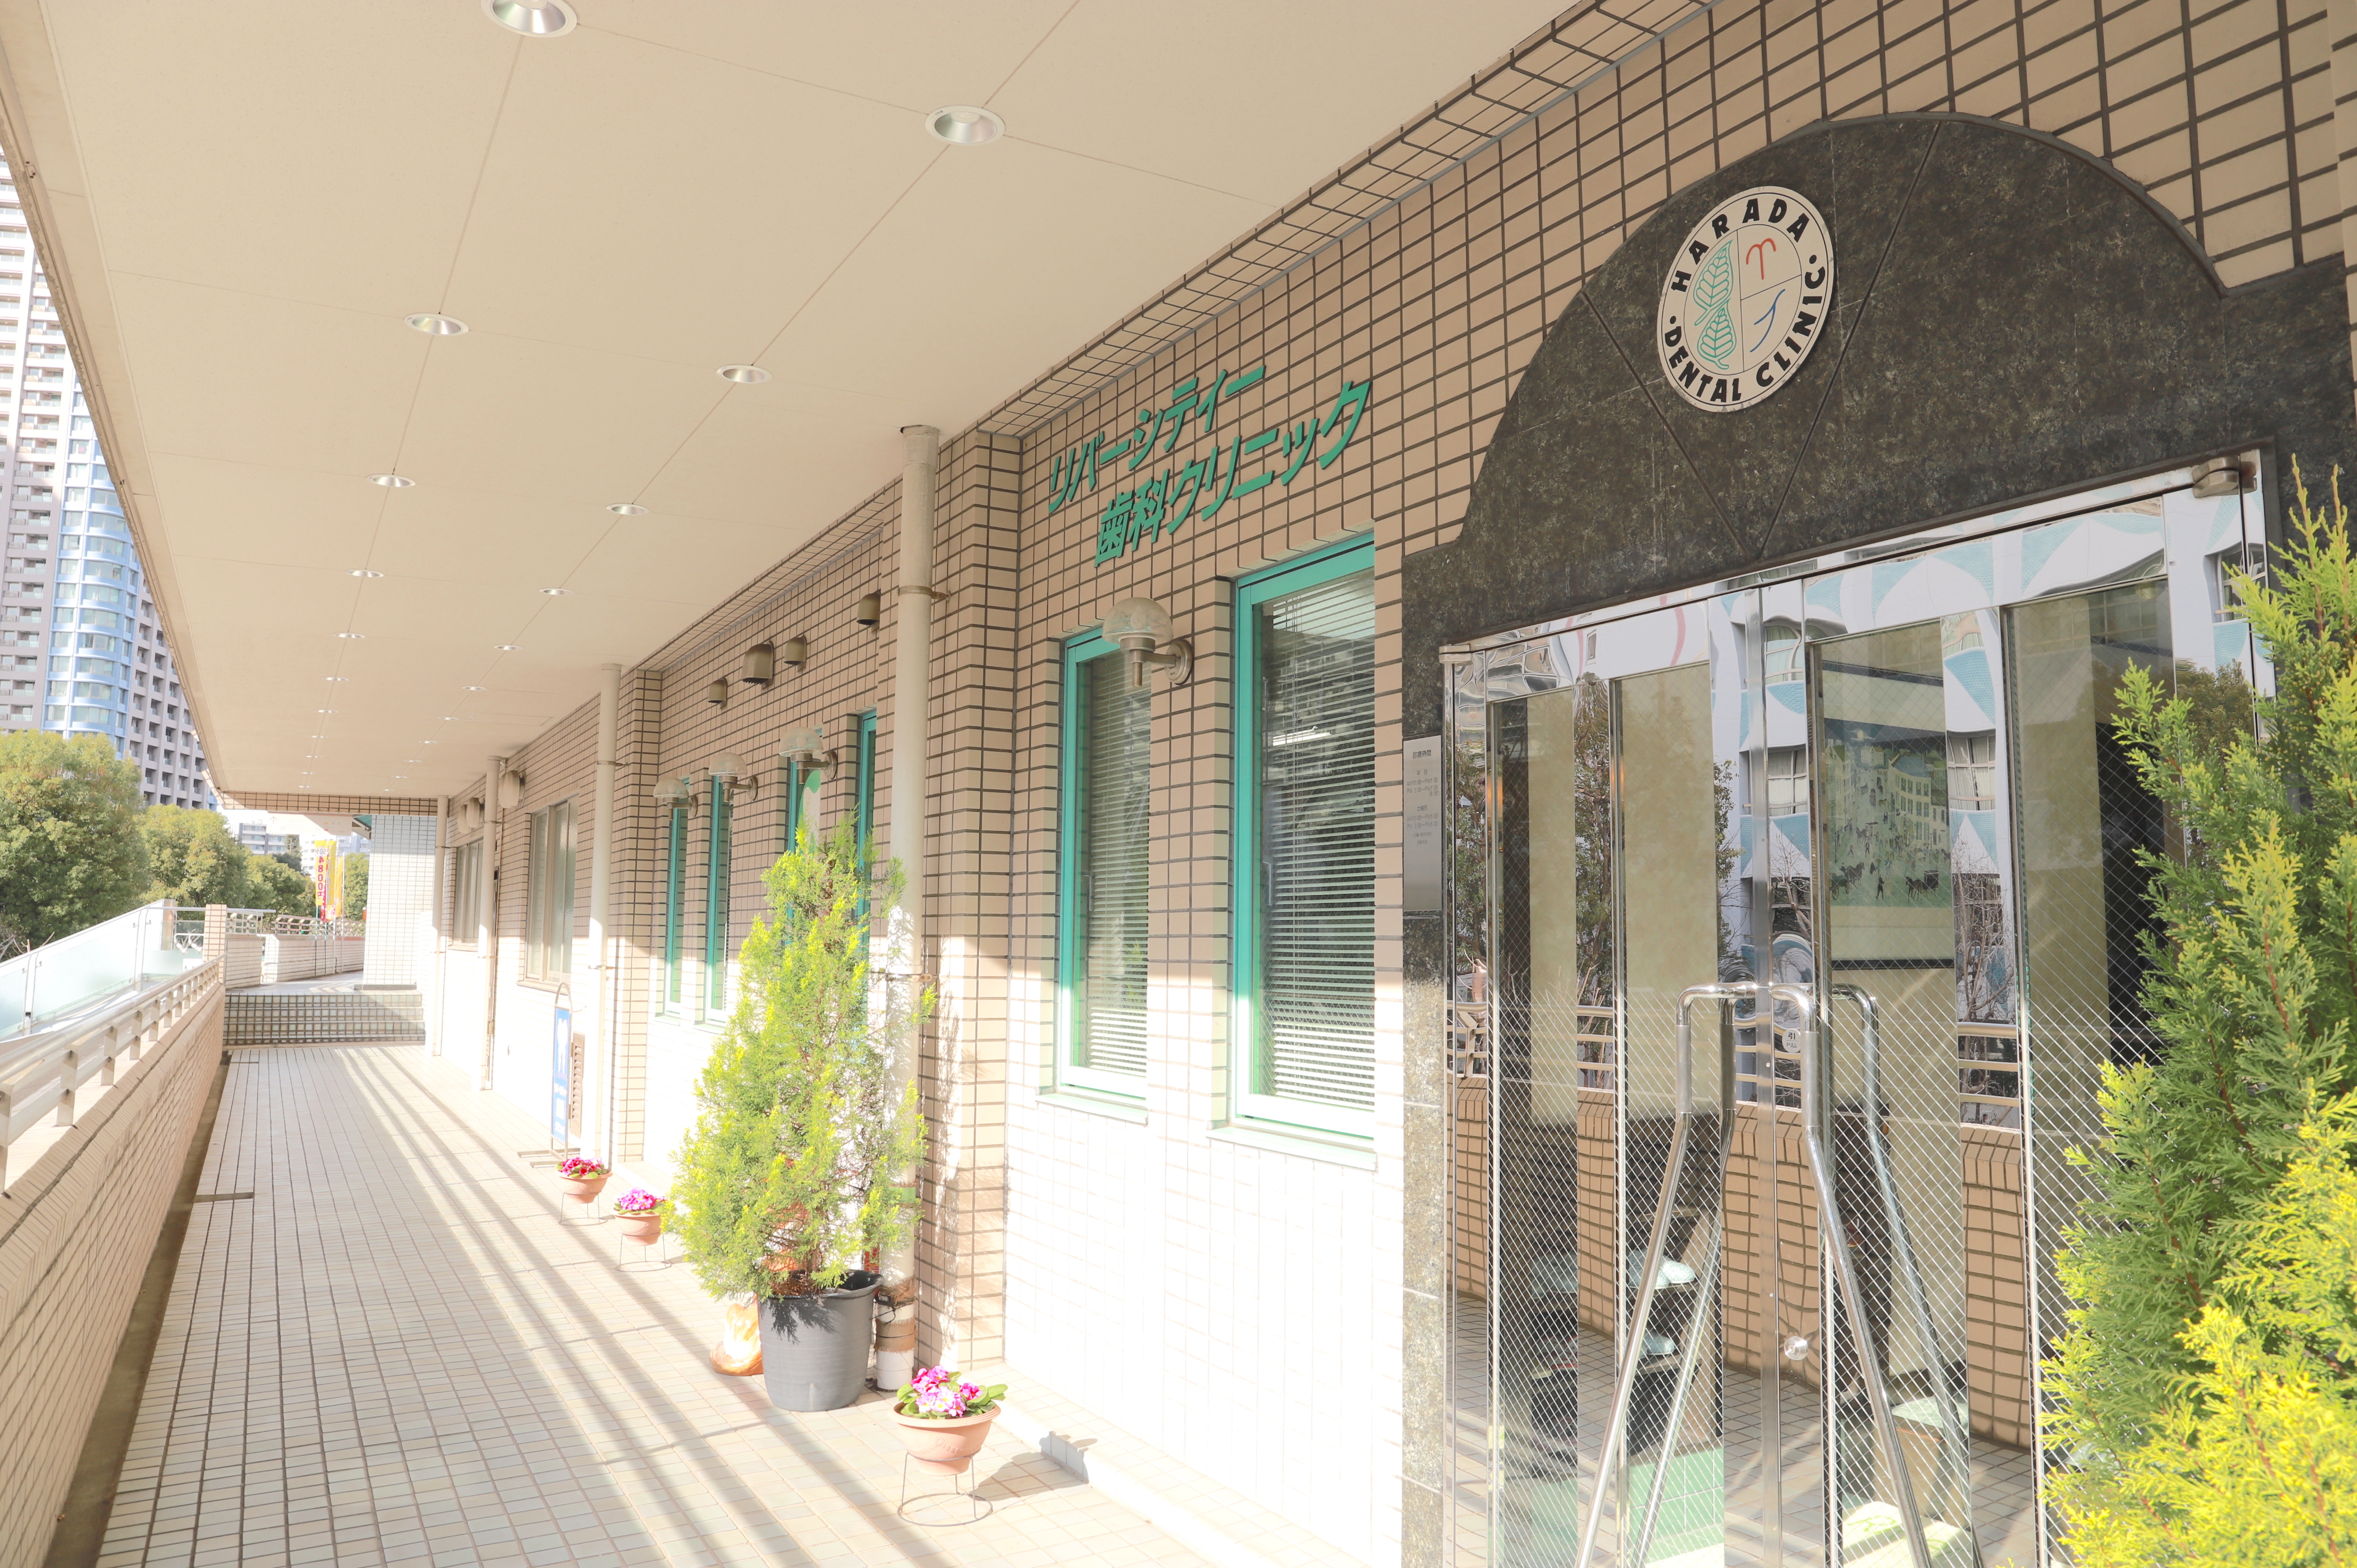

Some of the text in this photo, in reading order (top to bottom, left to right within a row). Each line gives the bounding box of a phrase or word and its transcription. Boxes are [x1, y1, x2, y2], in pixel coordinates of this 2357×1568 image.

[1671, 198, 1810, 292] HARADA
[1665, 266, 1826, 403] DENTAL CLINIC
[1048, 365, 1266, 514] リバーシティー
[1094, 381, 1371, 568] 歯科クリニック
[1413, 749, 1432, 759] 診療時間
